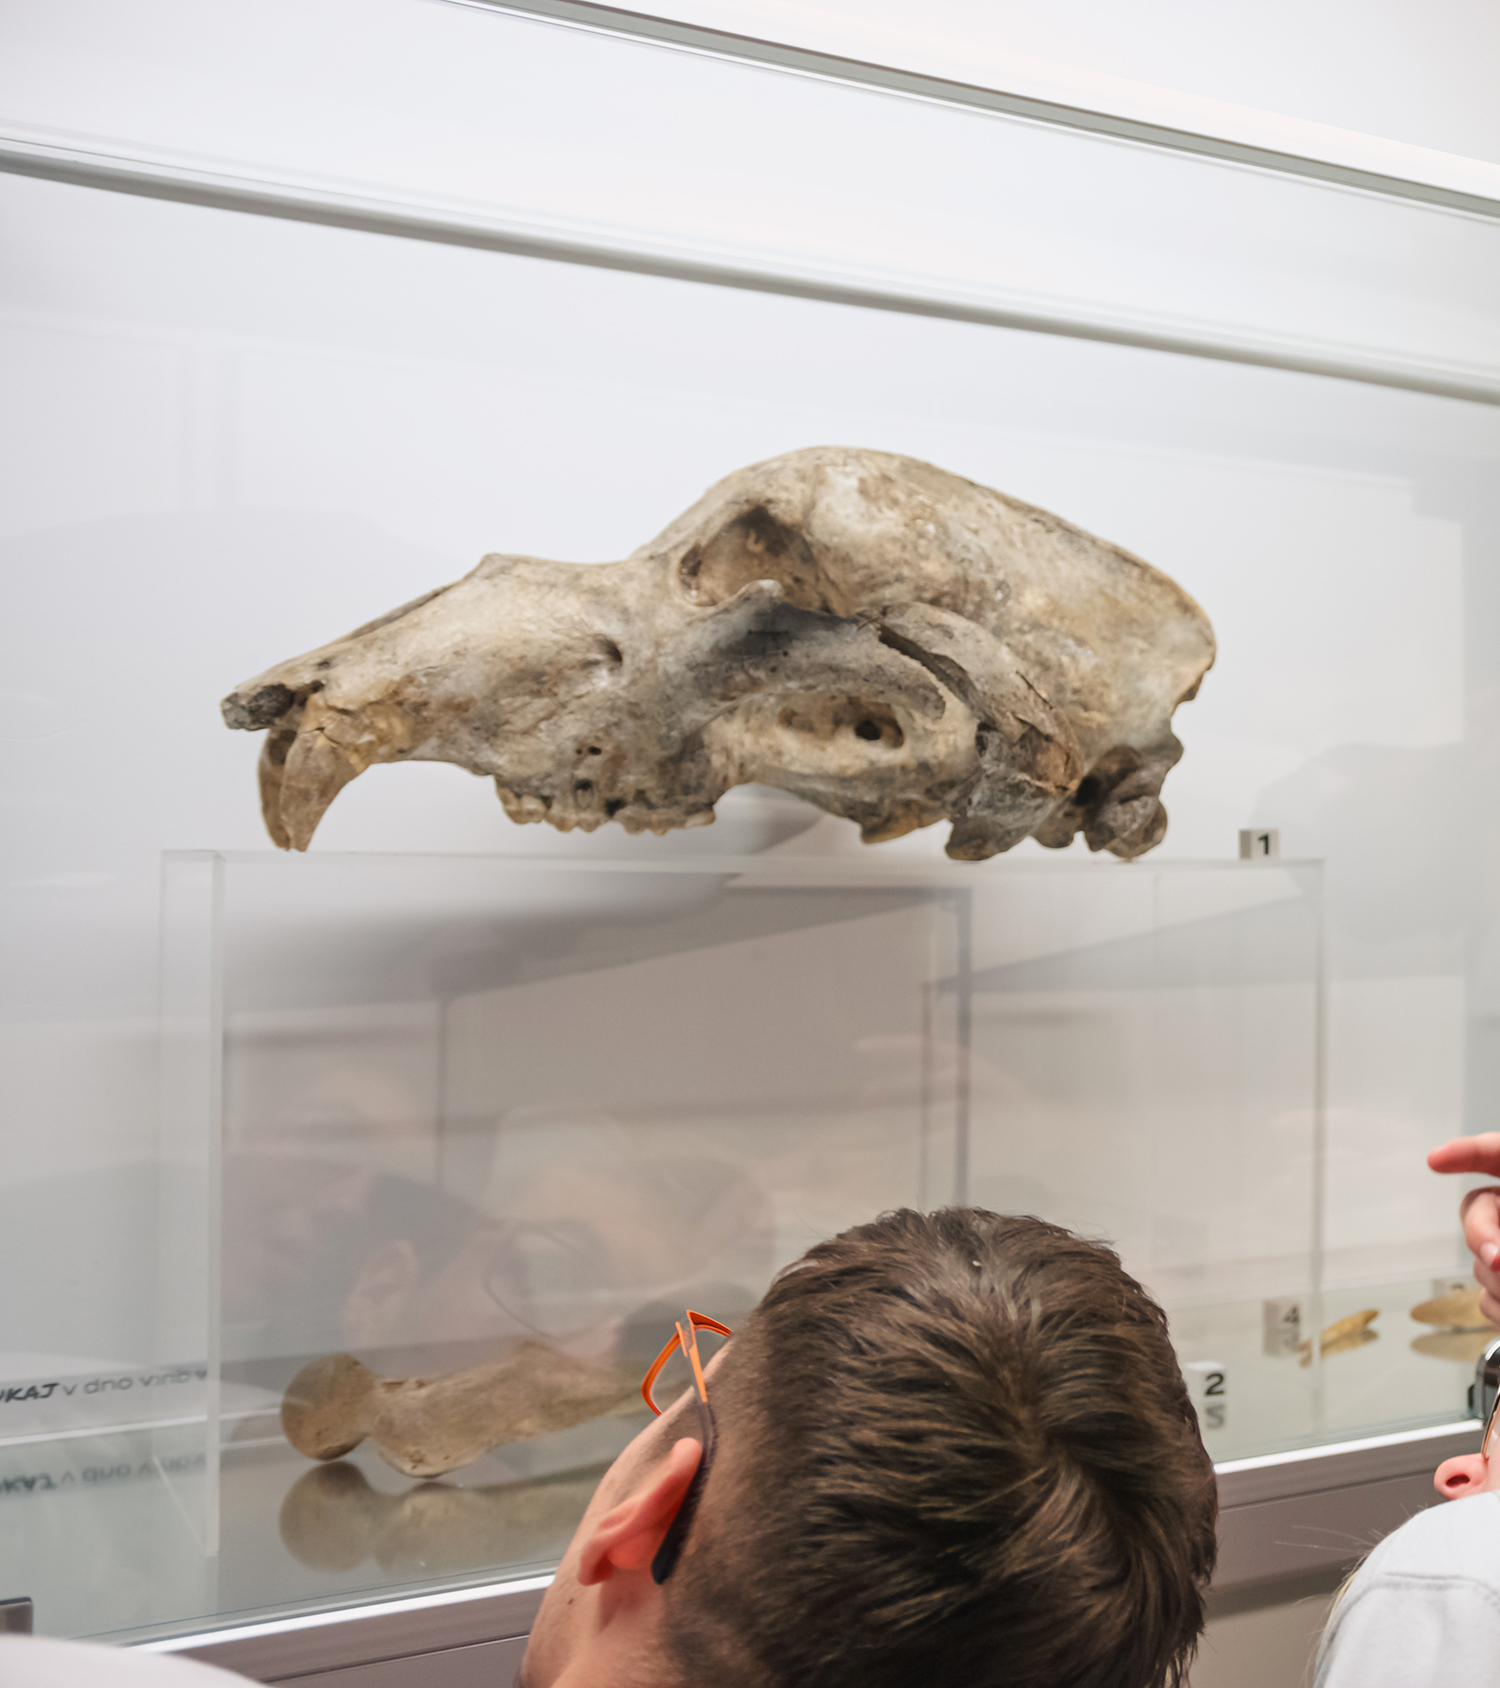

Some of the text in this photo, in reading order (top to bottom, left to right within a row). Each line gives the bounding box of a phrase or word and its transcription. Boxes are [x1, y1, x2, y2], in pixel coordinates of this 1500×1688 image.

[1258, 833, 1269, 855] 1
[1282, 1305, 1300, 1324] 4
[84, 1377, 132, 1394] dno
[1205, 1373, 1225, 1396] 2
